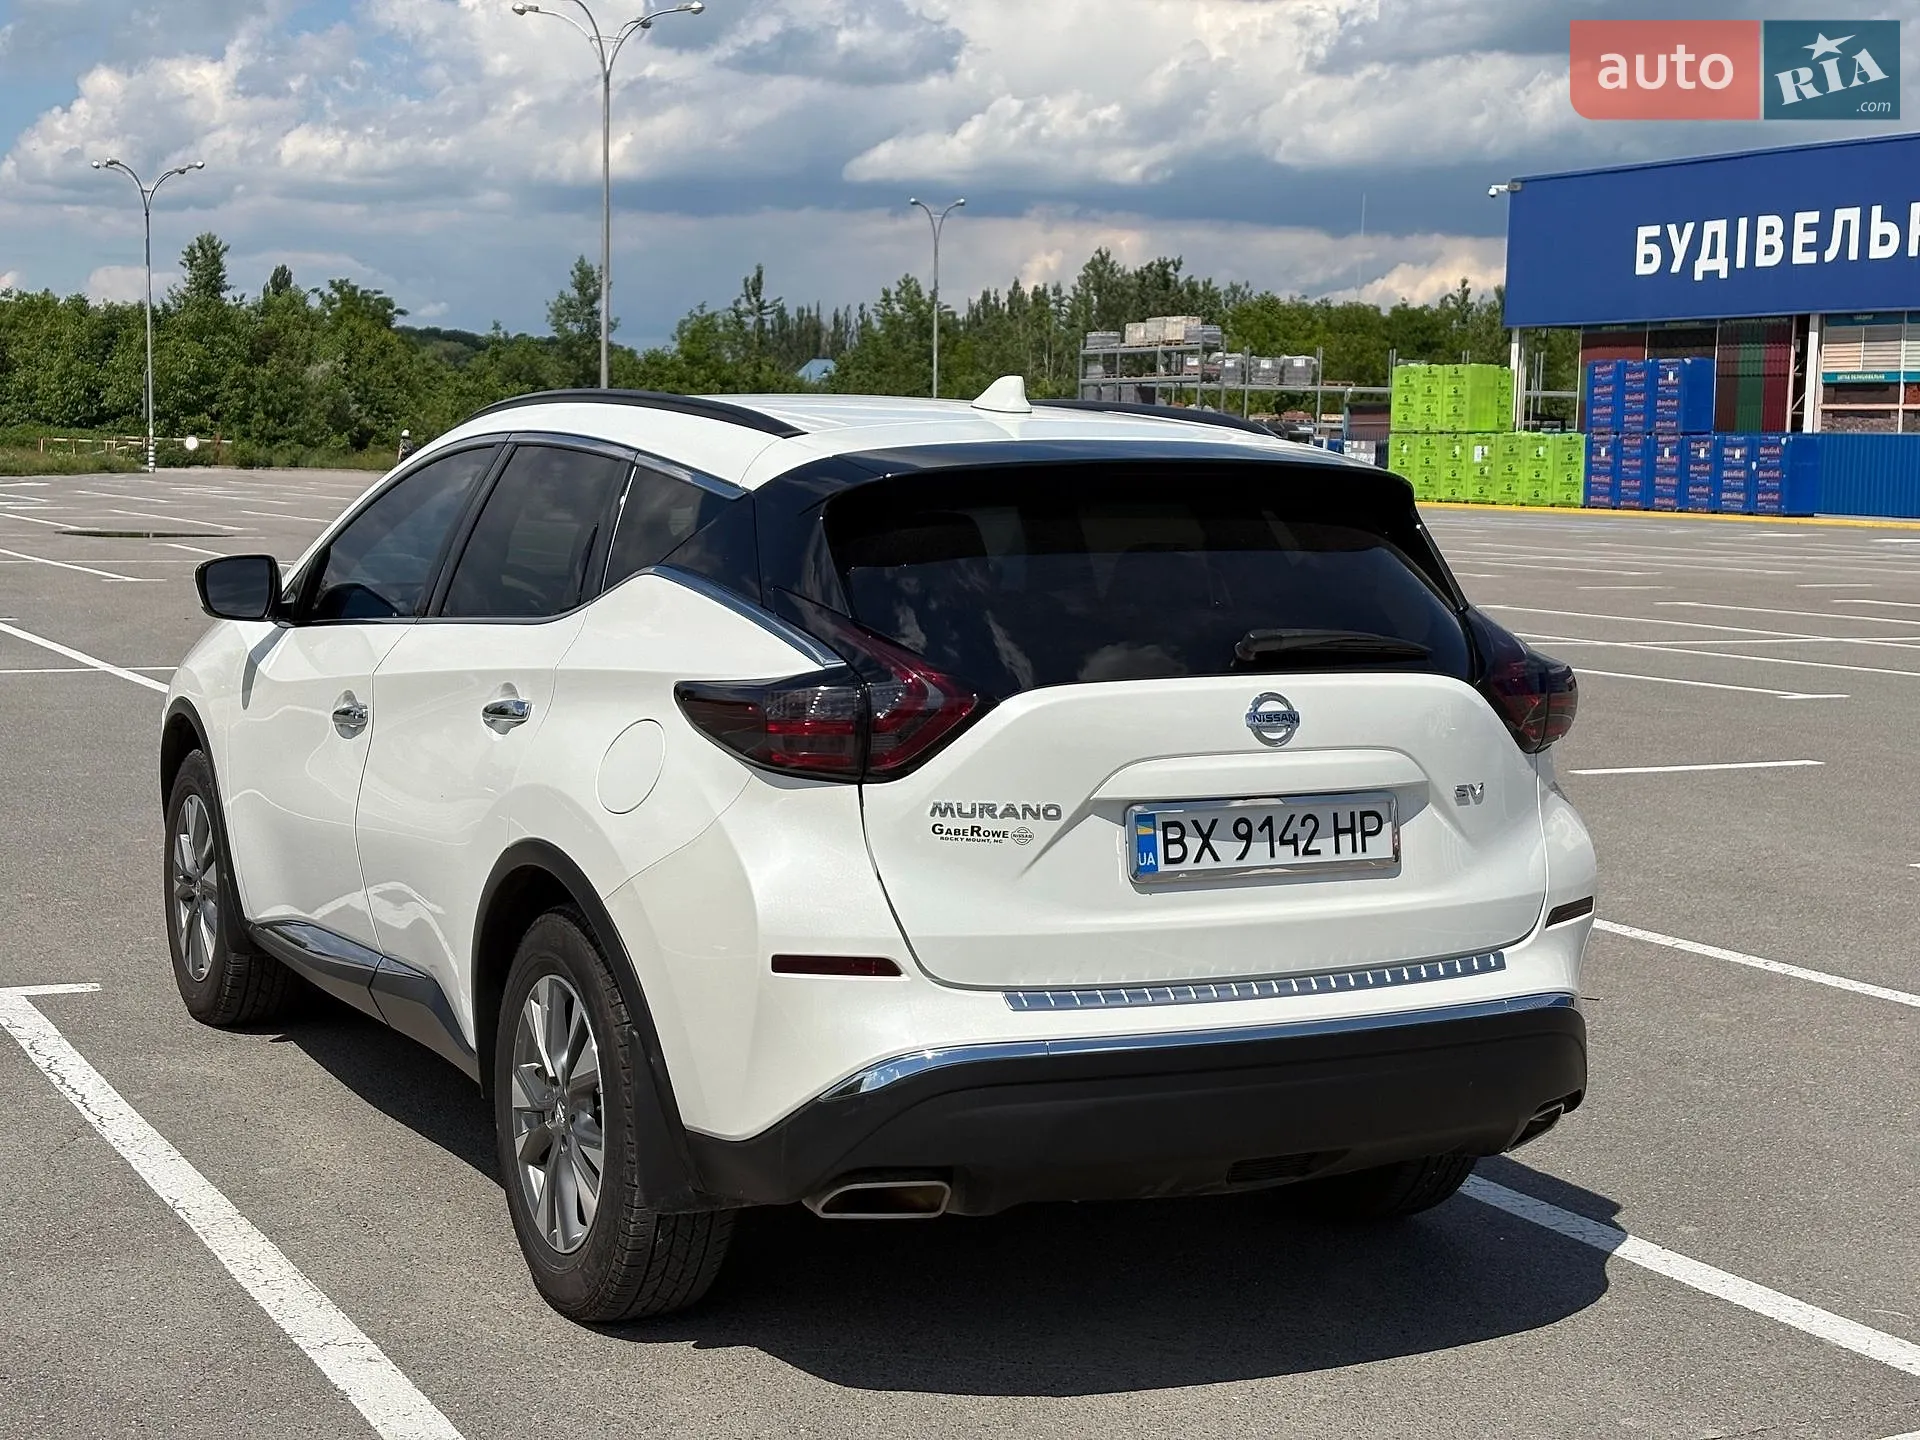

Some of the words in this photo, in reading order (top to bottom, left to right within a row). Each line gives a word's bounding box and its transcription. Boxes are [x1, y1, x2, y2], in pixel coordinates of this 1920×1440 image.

[1252, 713, 1296, 723] NISSAN
[1454, 782, 1484, 807] SV
[930, 801, 1062, 821] MURANO
[1161, 818, 1221, 865] BX
[1232, 813, 1321, 861] 9142
[1332, 810, 1384, 855] HP
[1138, 852, 1156, 866] UA
